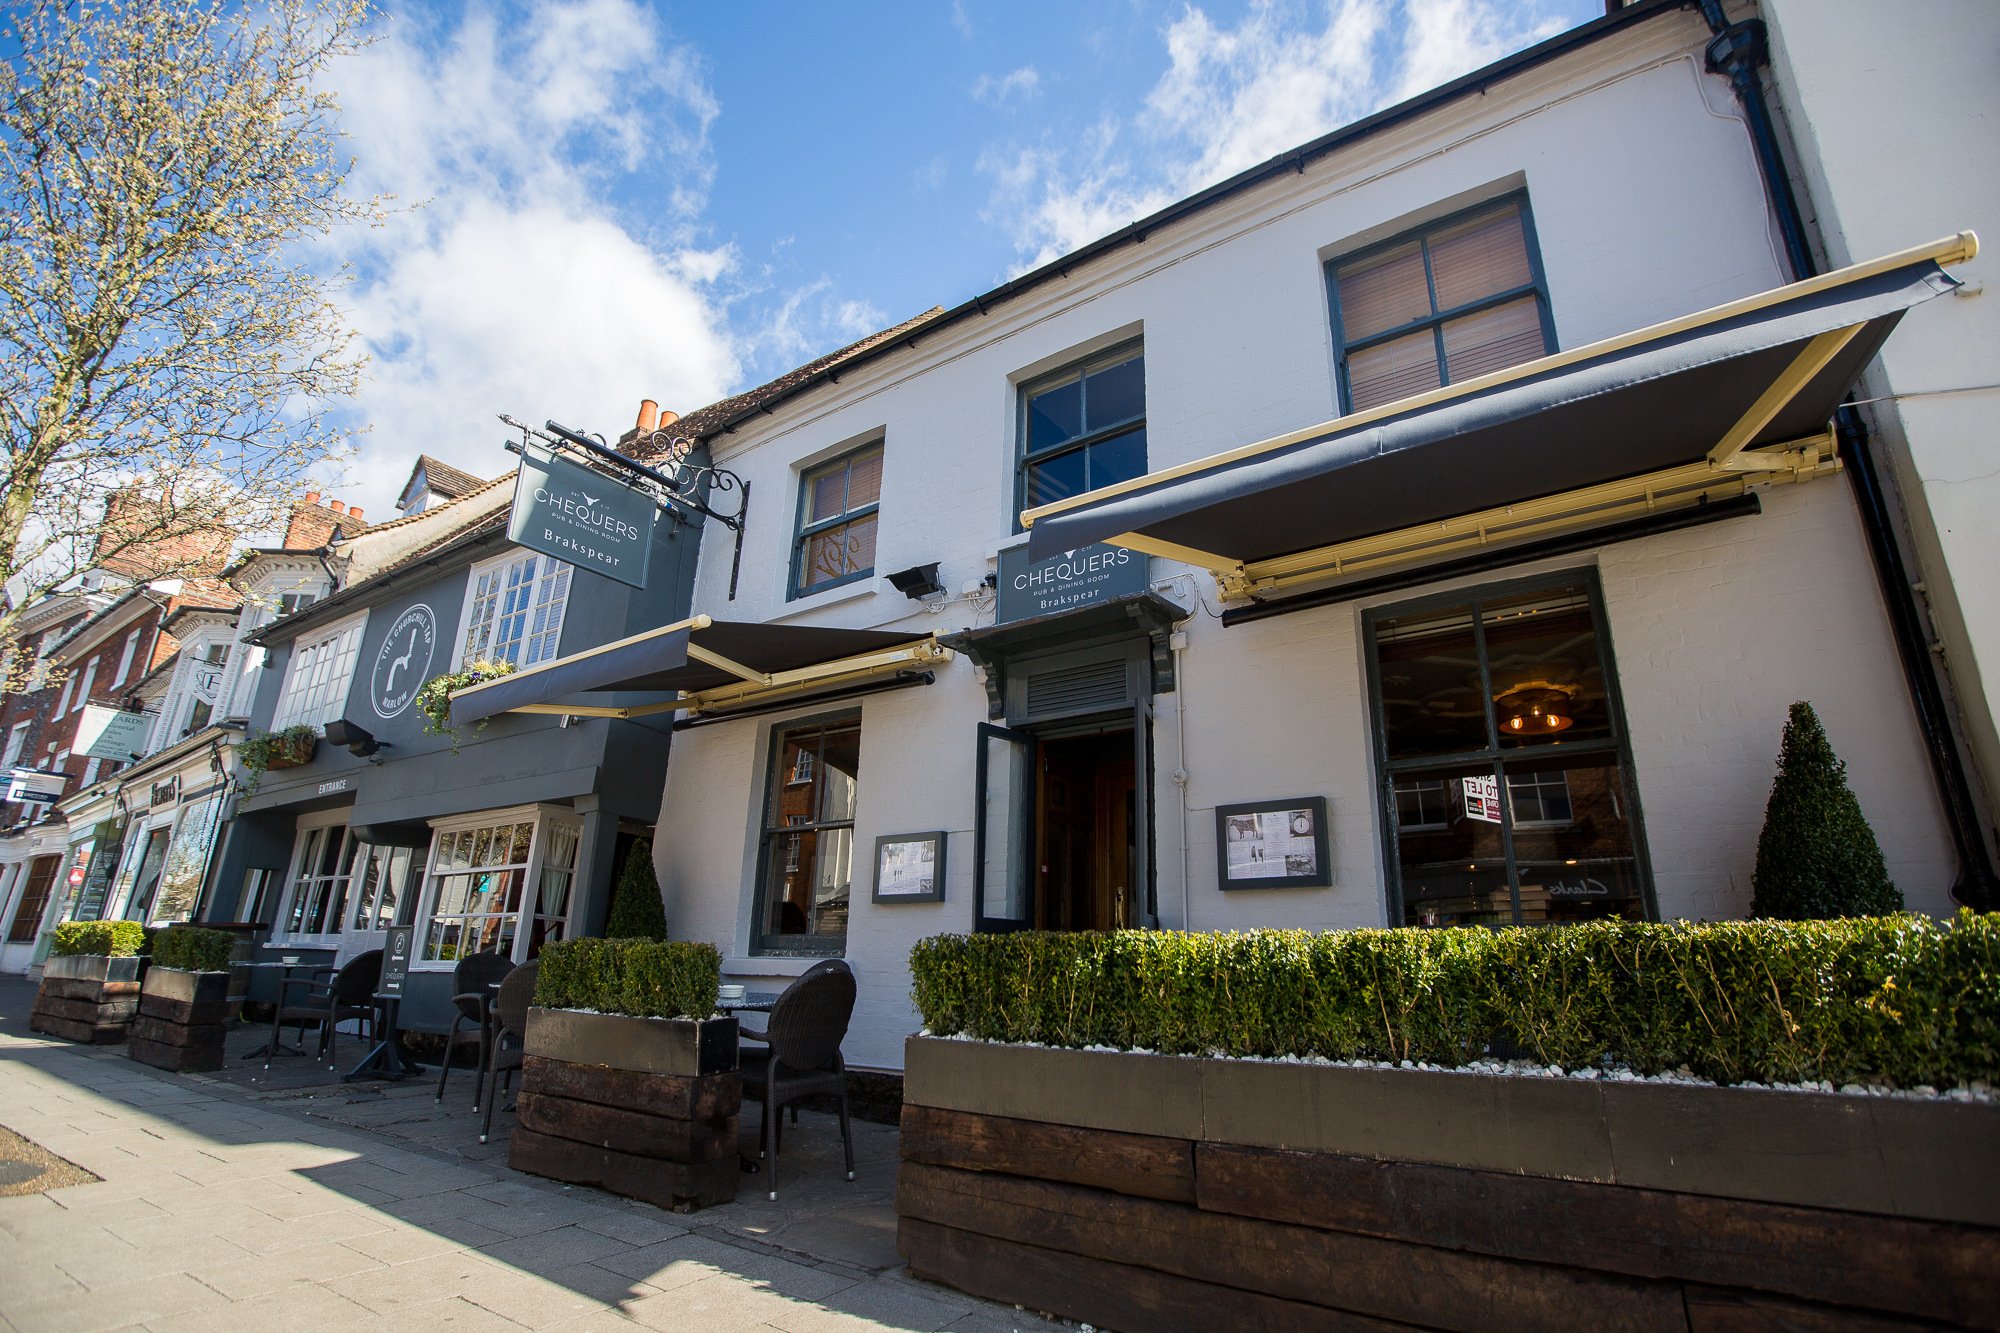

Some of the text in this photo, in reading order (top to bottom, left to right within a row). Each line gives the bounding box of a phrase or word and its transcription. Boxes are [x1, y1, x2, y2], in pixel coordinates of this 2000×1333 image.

[534, 487, 638, 541] CHEQUERS
[551, 511, 566, 521] PUB
[575, 521, 599, 535] DINING
[601, 532, 621, 543] ROOM
[544, 528, 621, 566] Brakspear
[1013, 548, 1130, 591] CHEQUERS
[1033, 588, 1048, 597] PUB
[1057, 579, 1085, 591] DINING
[1087, 573, 1110, 584] ROOM
[1040, 588, 1100, 609] Brakspear
[381, 611, 432, 660] THE CHURCHILL TAP
[382, 690, 408, 709] MARLOW
[318, 779, 347, 794] ENTRANCE
[385, 972, 405, 980] CHEQUERS
